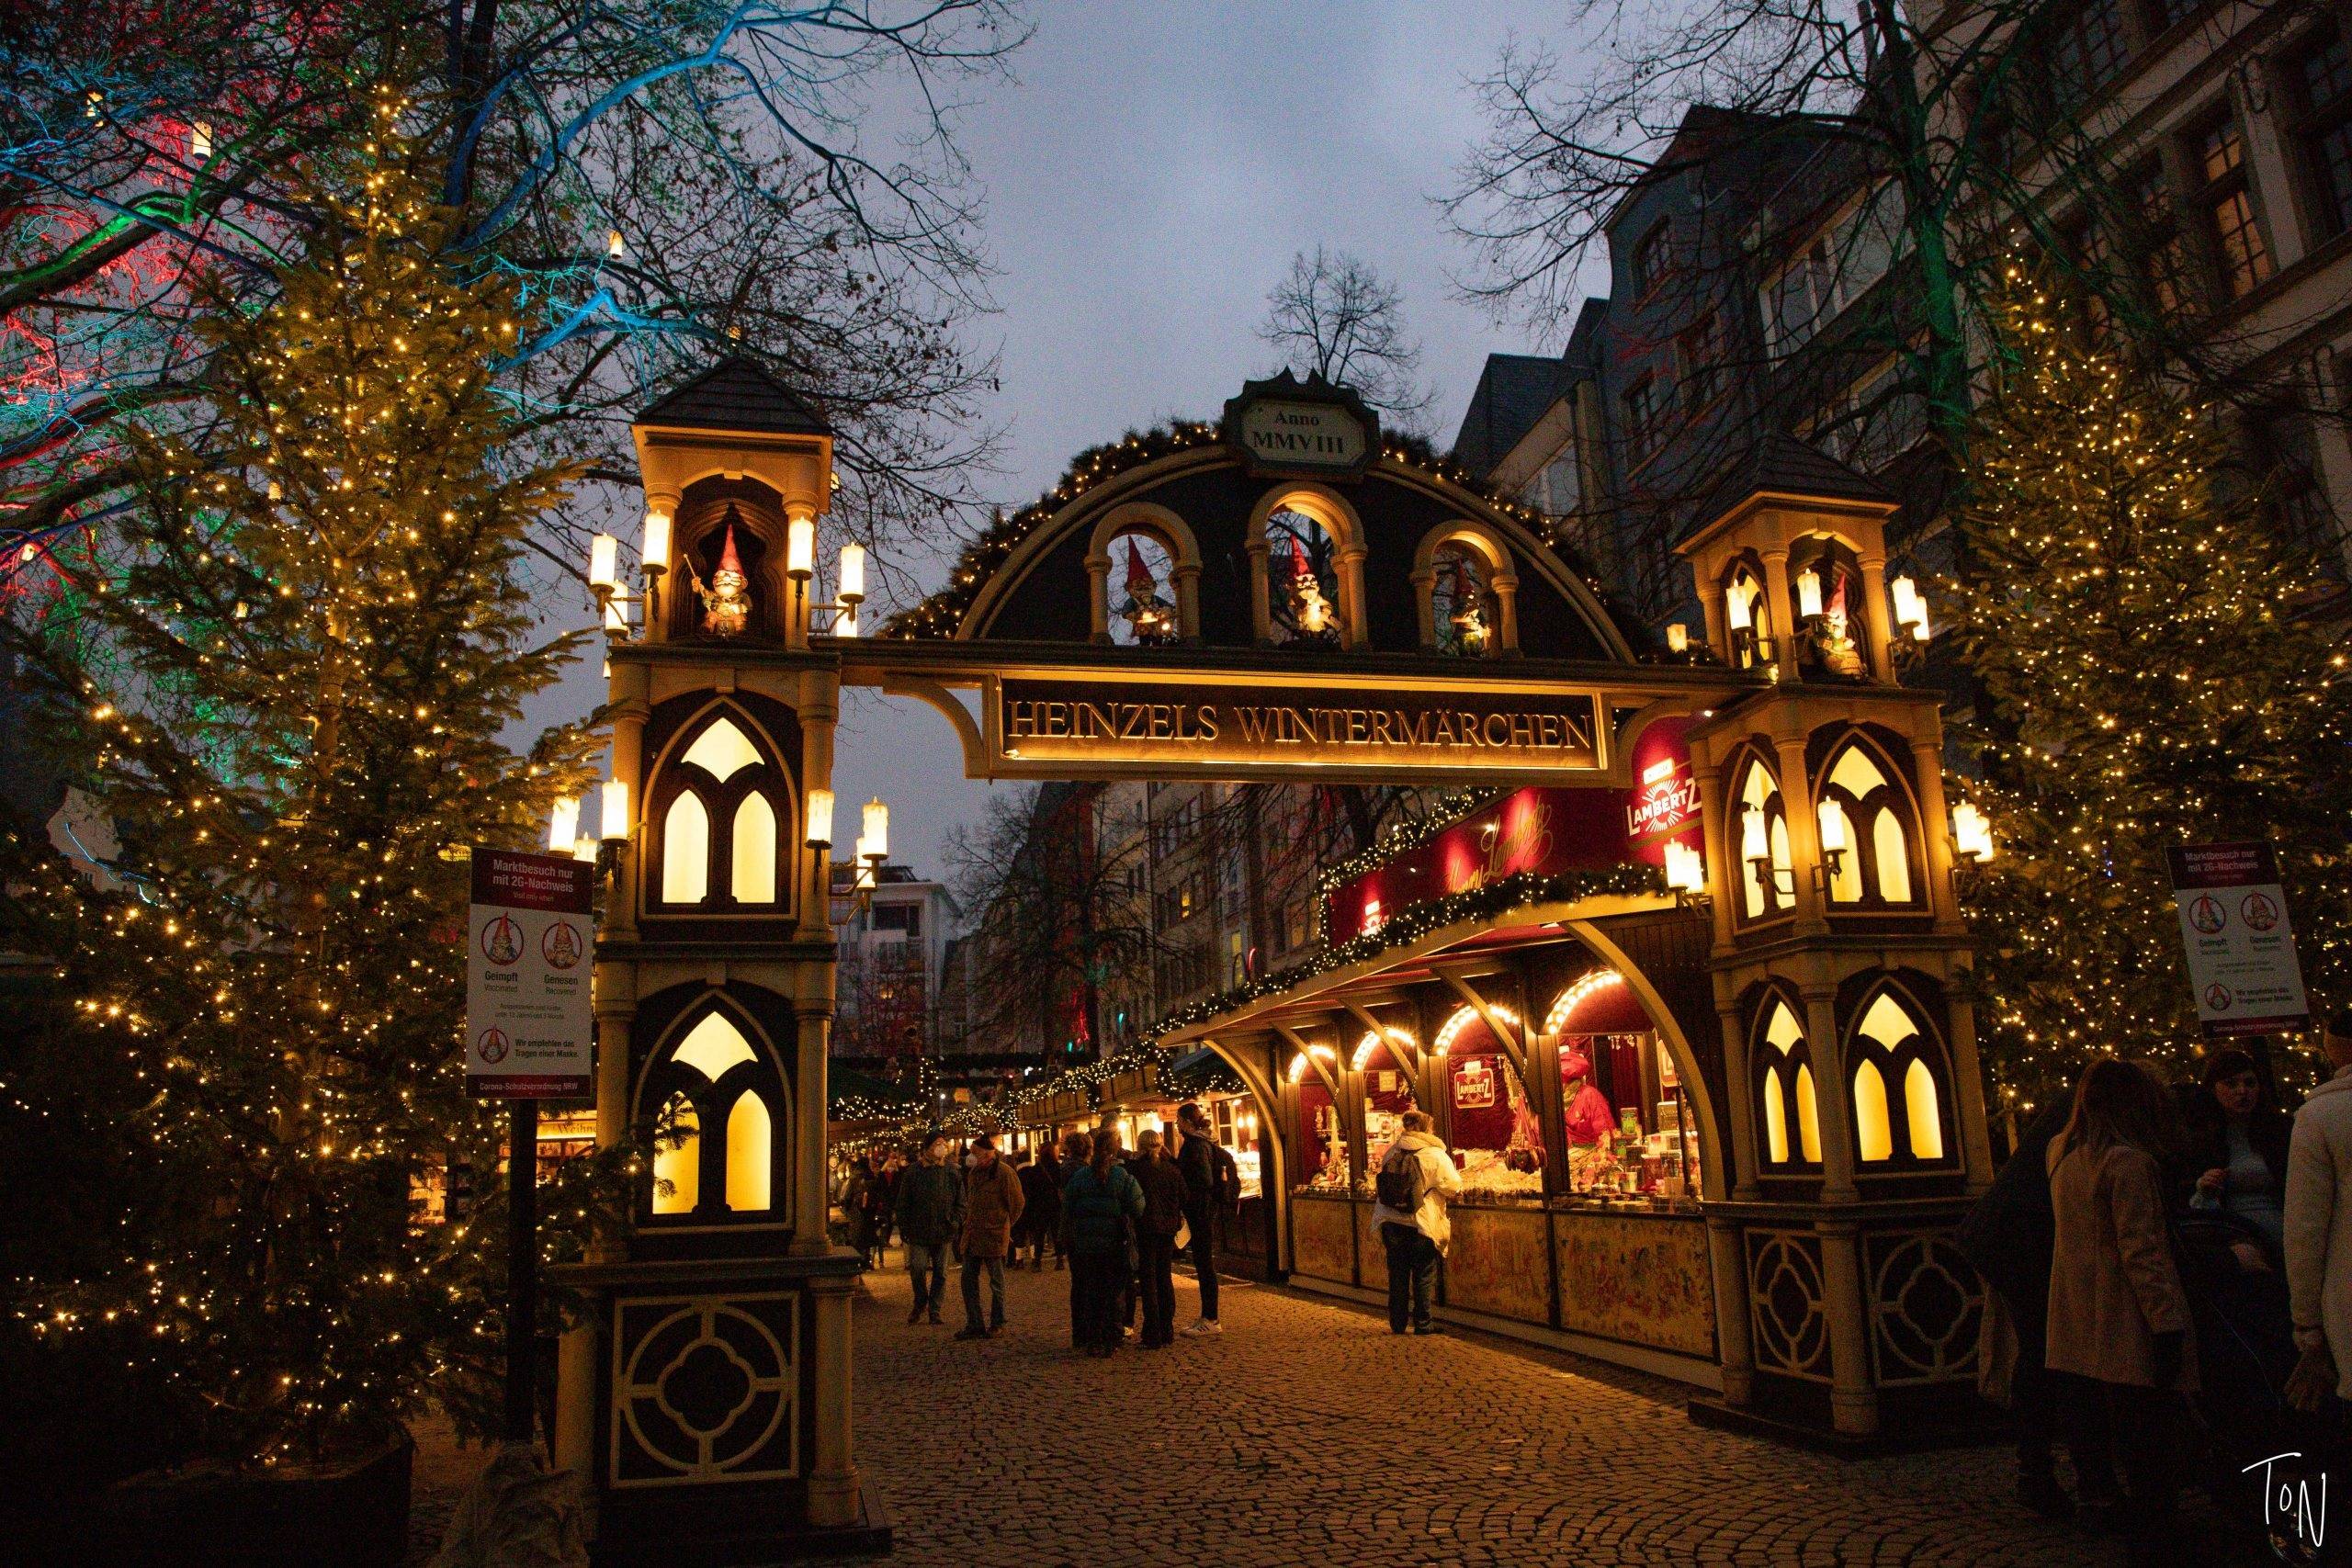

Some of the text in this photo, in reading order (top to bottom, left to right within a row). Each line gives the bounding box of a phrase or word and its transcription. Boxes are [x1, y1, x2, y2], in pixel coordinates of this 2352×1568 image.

[1275, 411, 1320, 426] Anno
[1251, 430, 1344, 454] MMVIII
[1008, 701, 1591, 750] HEINZELS WINTERMÄRCHEN
[1626, 777, 1702, 837] LAMBERTZ
[492, 859, 574, 879] Marktbesuch nur
[492, 874, 574, 893] mit 2G-Nachweis
[485, 970, 518, 983] Geimpft
[544, 974, 579, 986] Genesen
